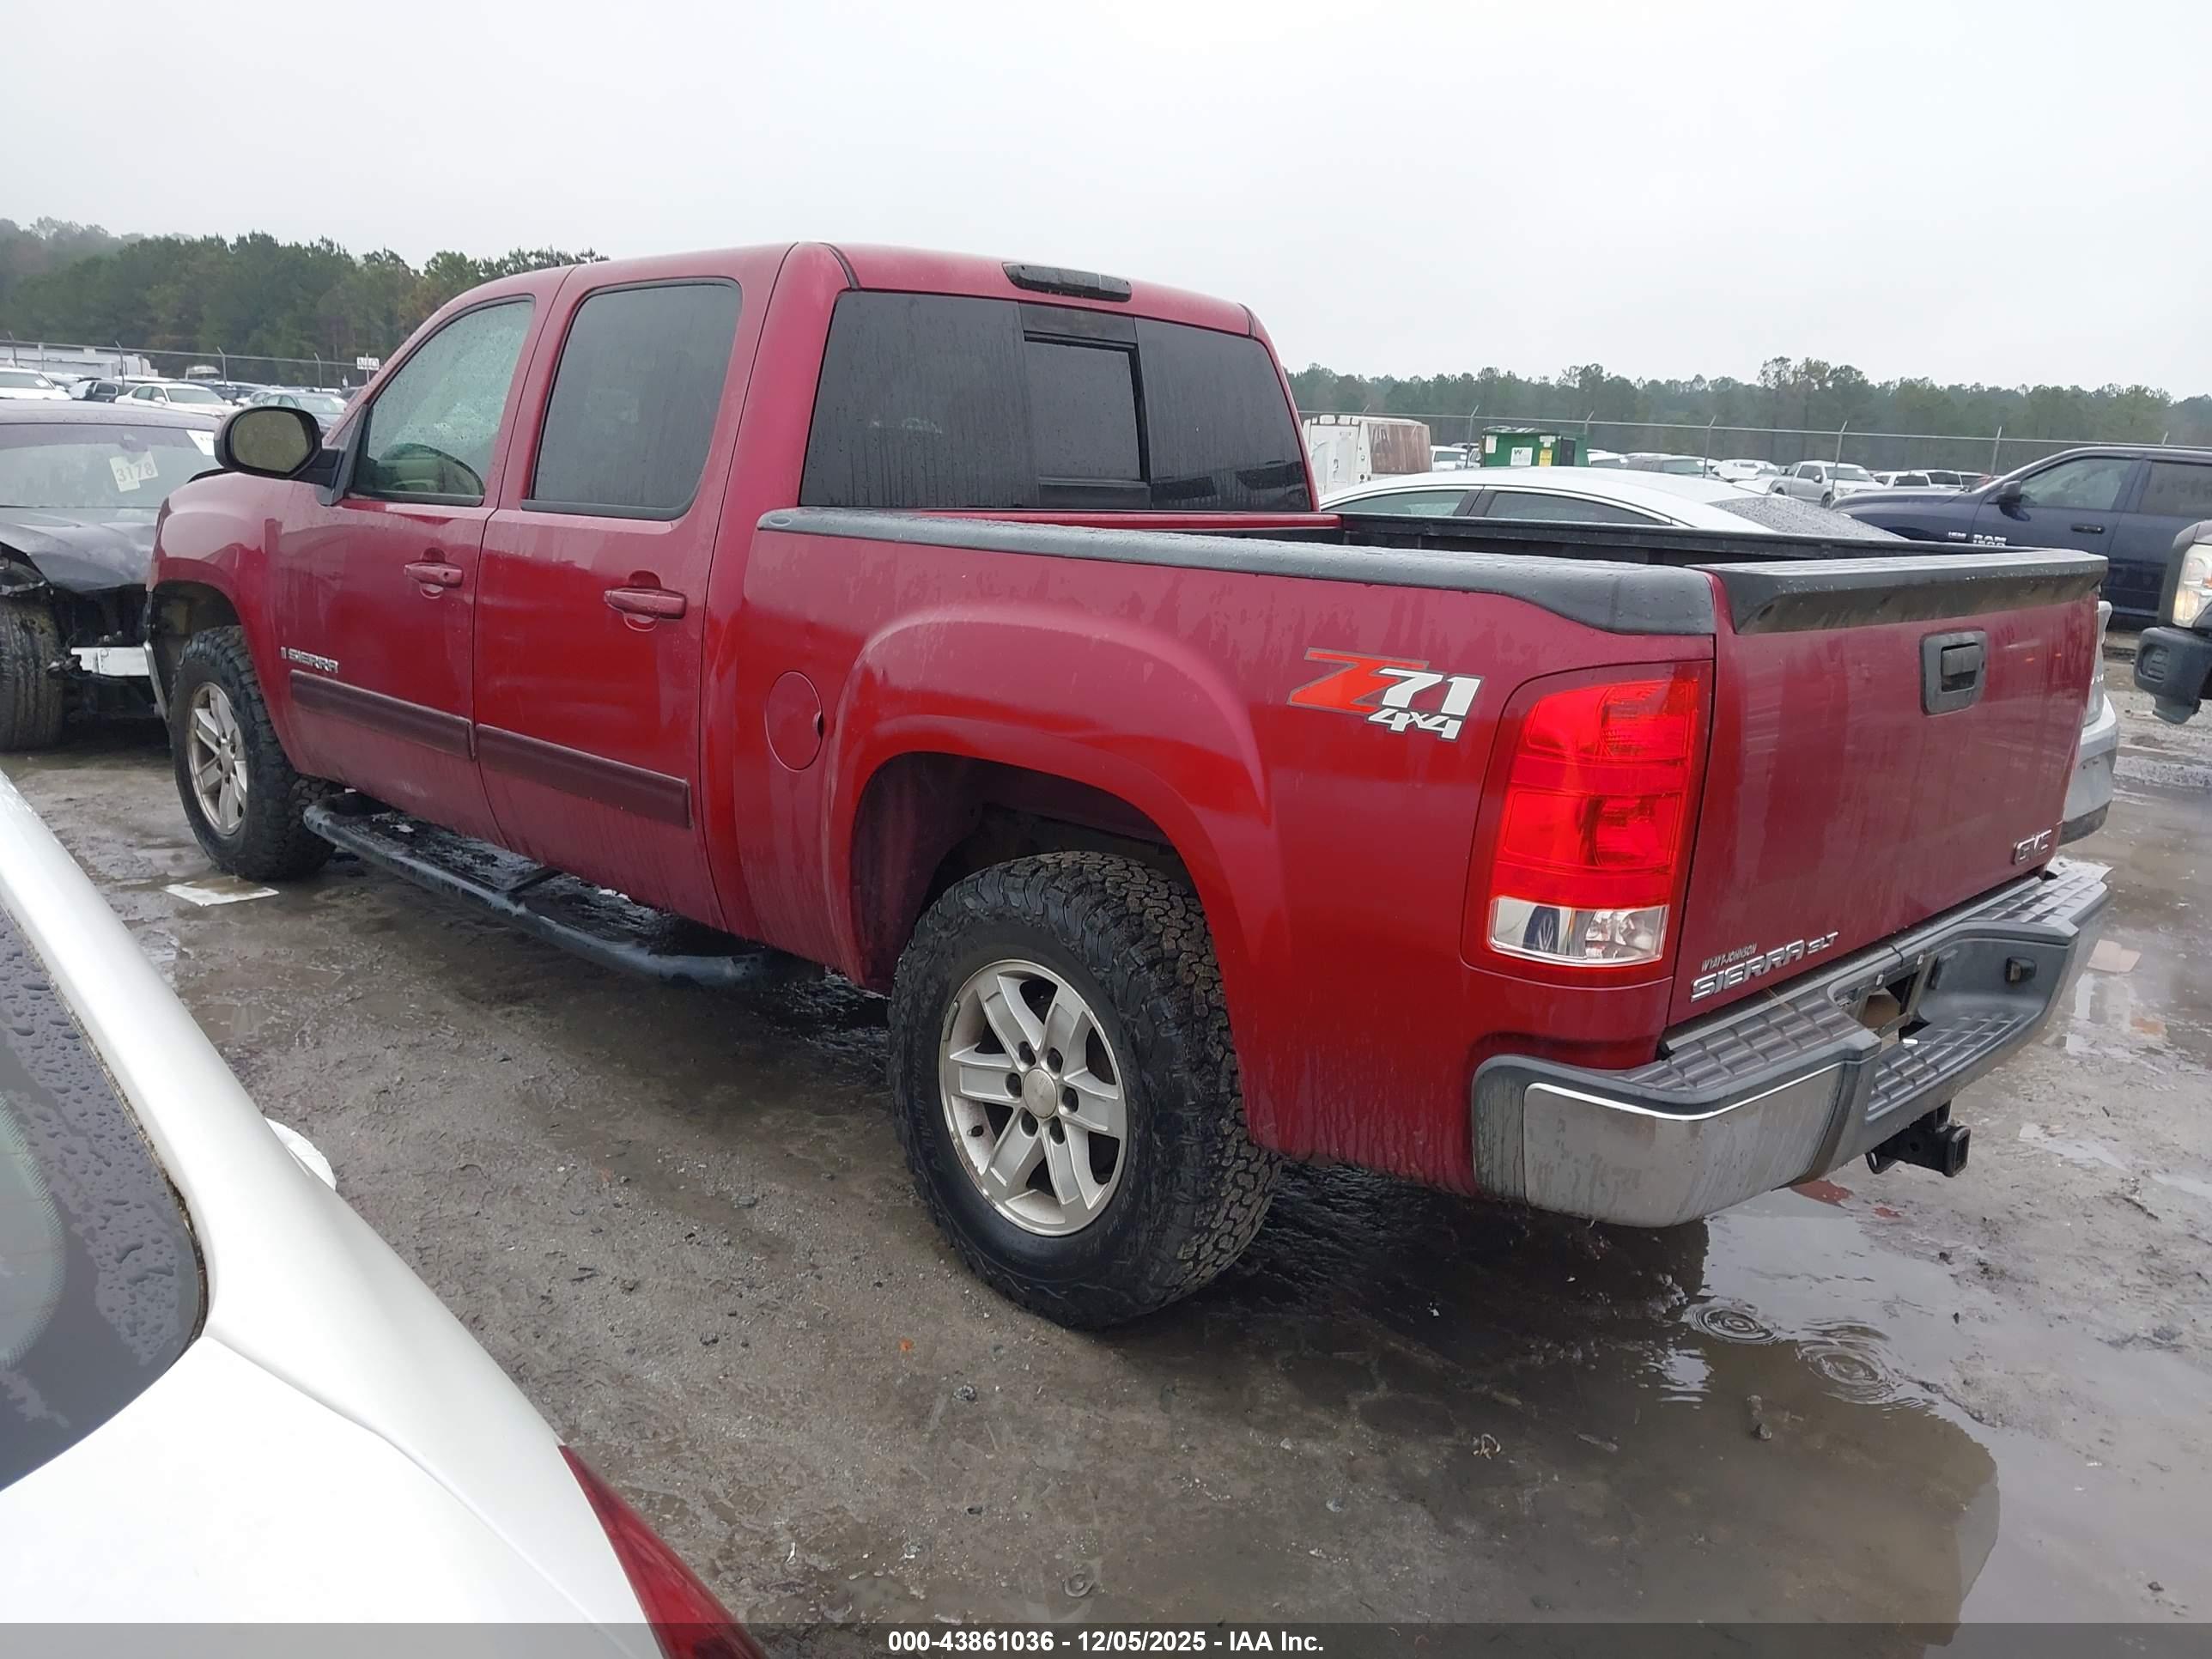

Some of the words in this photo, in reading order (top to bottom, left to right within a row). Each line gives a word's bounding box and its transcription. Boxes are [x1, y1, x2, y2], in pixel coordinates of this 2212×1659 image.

[116, 462, 155, 482] 3178
[1973, 534, 2007, 543] RAM
[289, 648, 338, 673] SIERRA
[1288, 647, 1484, 717] Z71
[1691, 939, 1805, 1003] SIERRA
[1807, 931, 1839, 955] SLT
